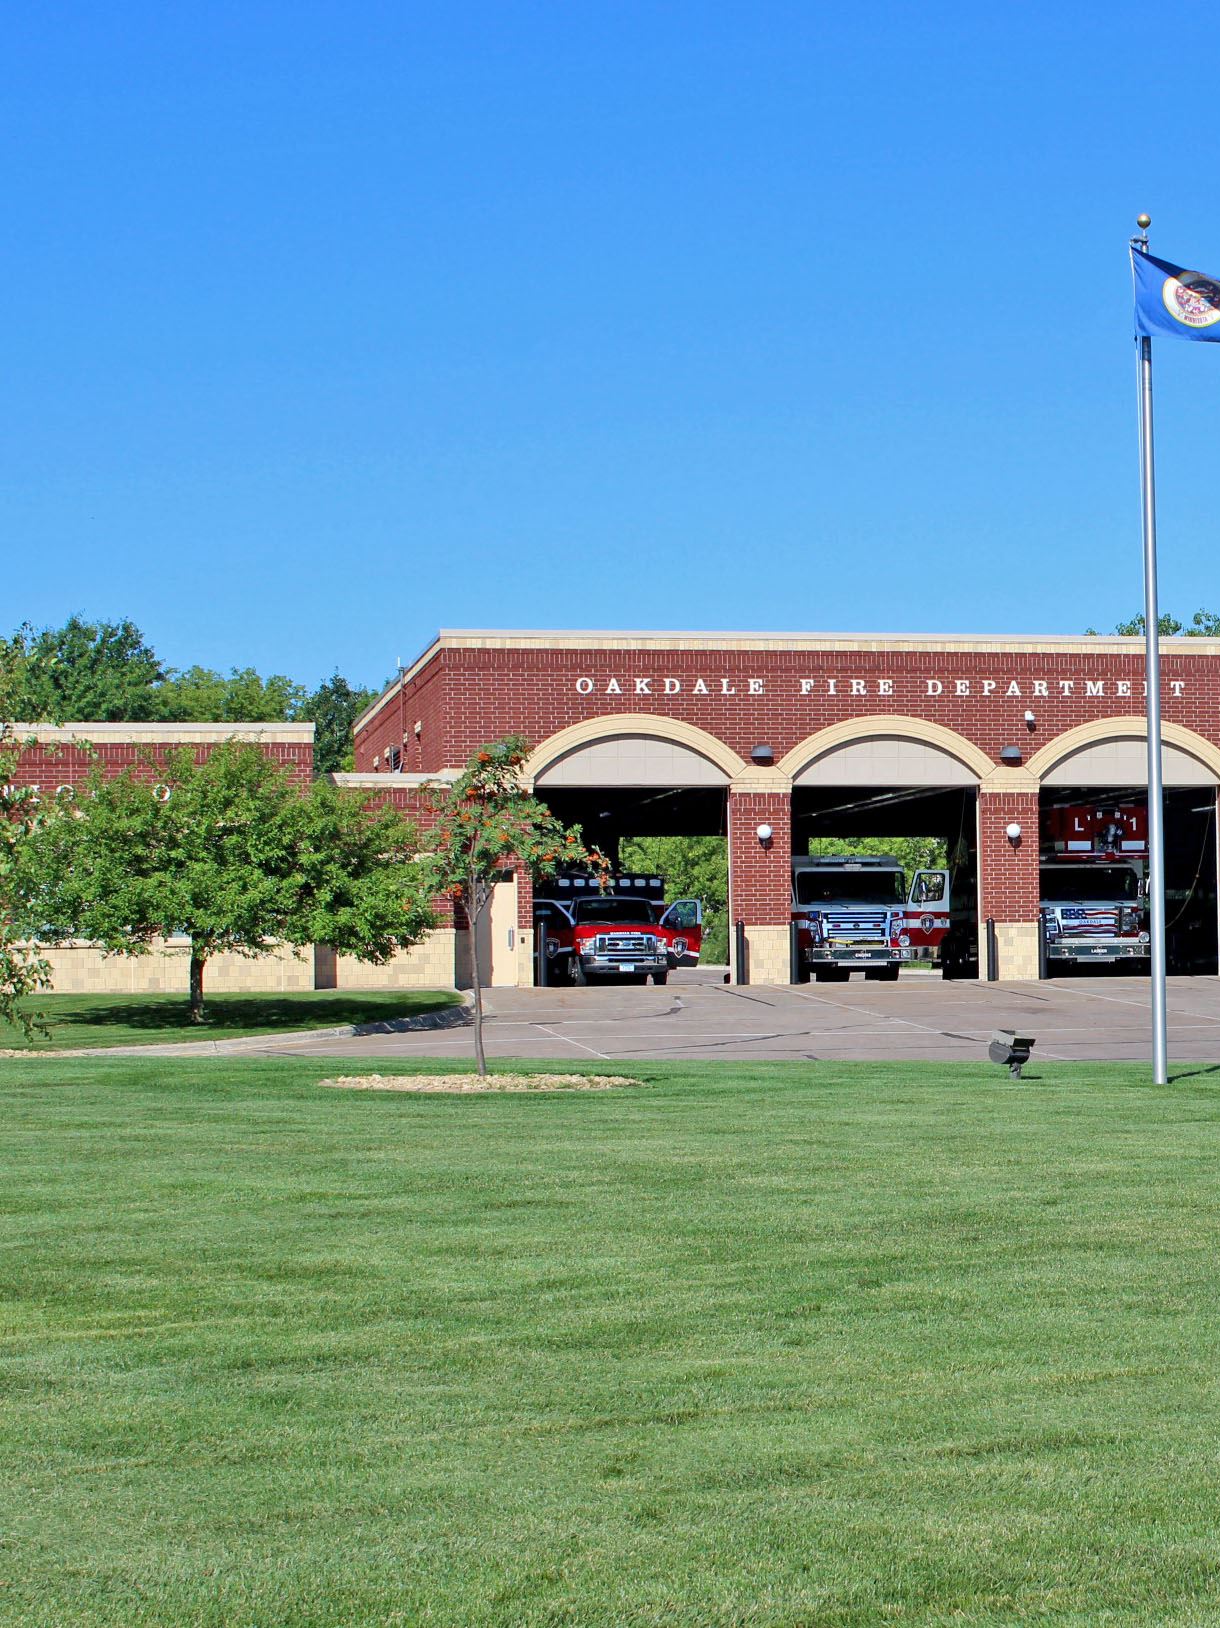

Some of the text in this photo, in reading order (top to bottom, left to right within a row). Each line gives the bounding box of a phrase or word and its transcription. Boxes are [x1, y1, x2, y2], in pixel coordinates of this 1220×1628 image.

[575, 677, 764, 695] OAKDALE
[800, 679, 893, 695] FIRE
[1074, 817, 1136, 831] L 1
